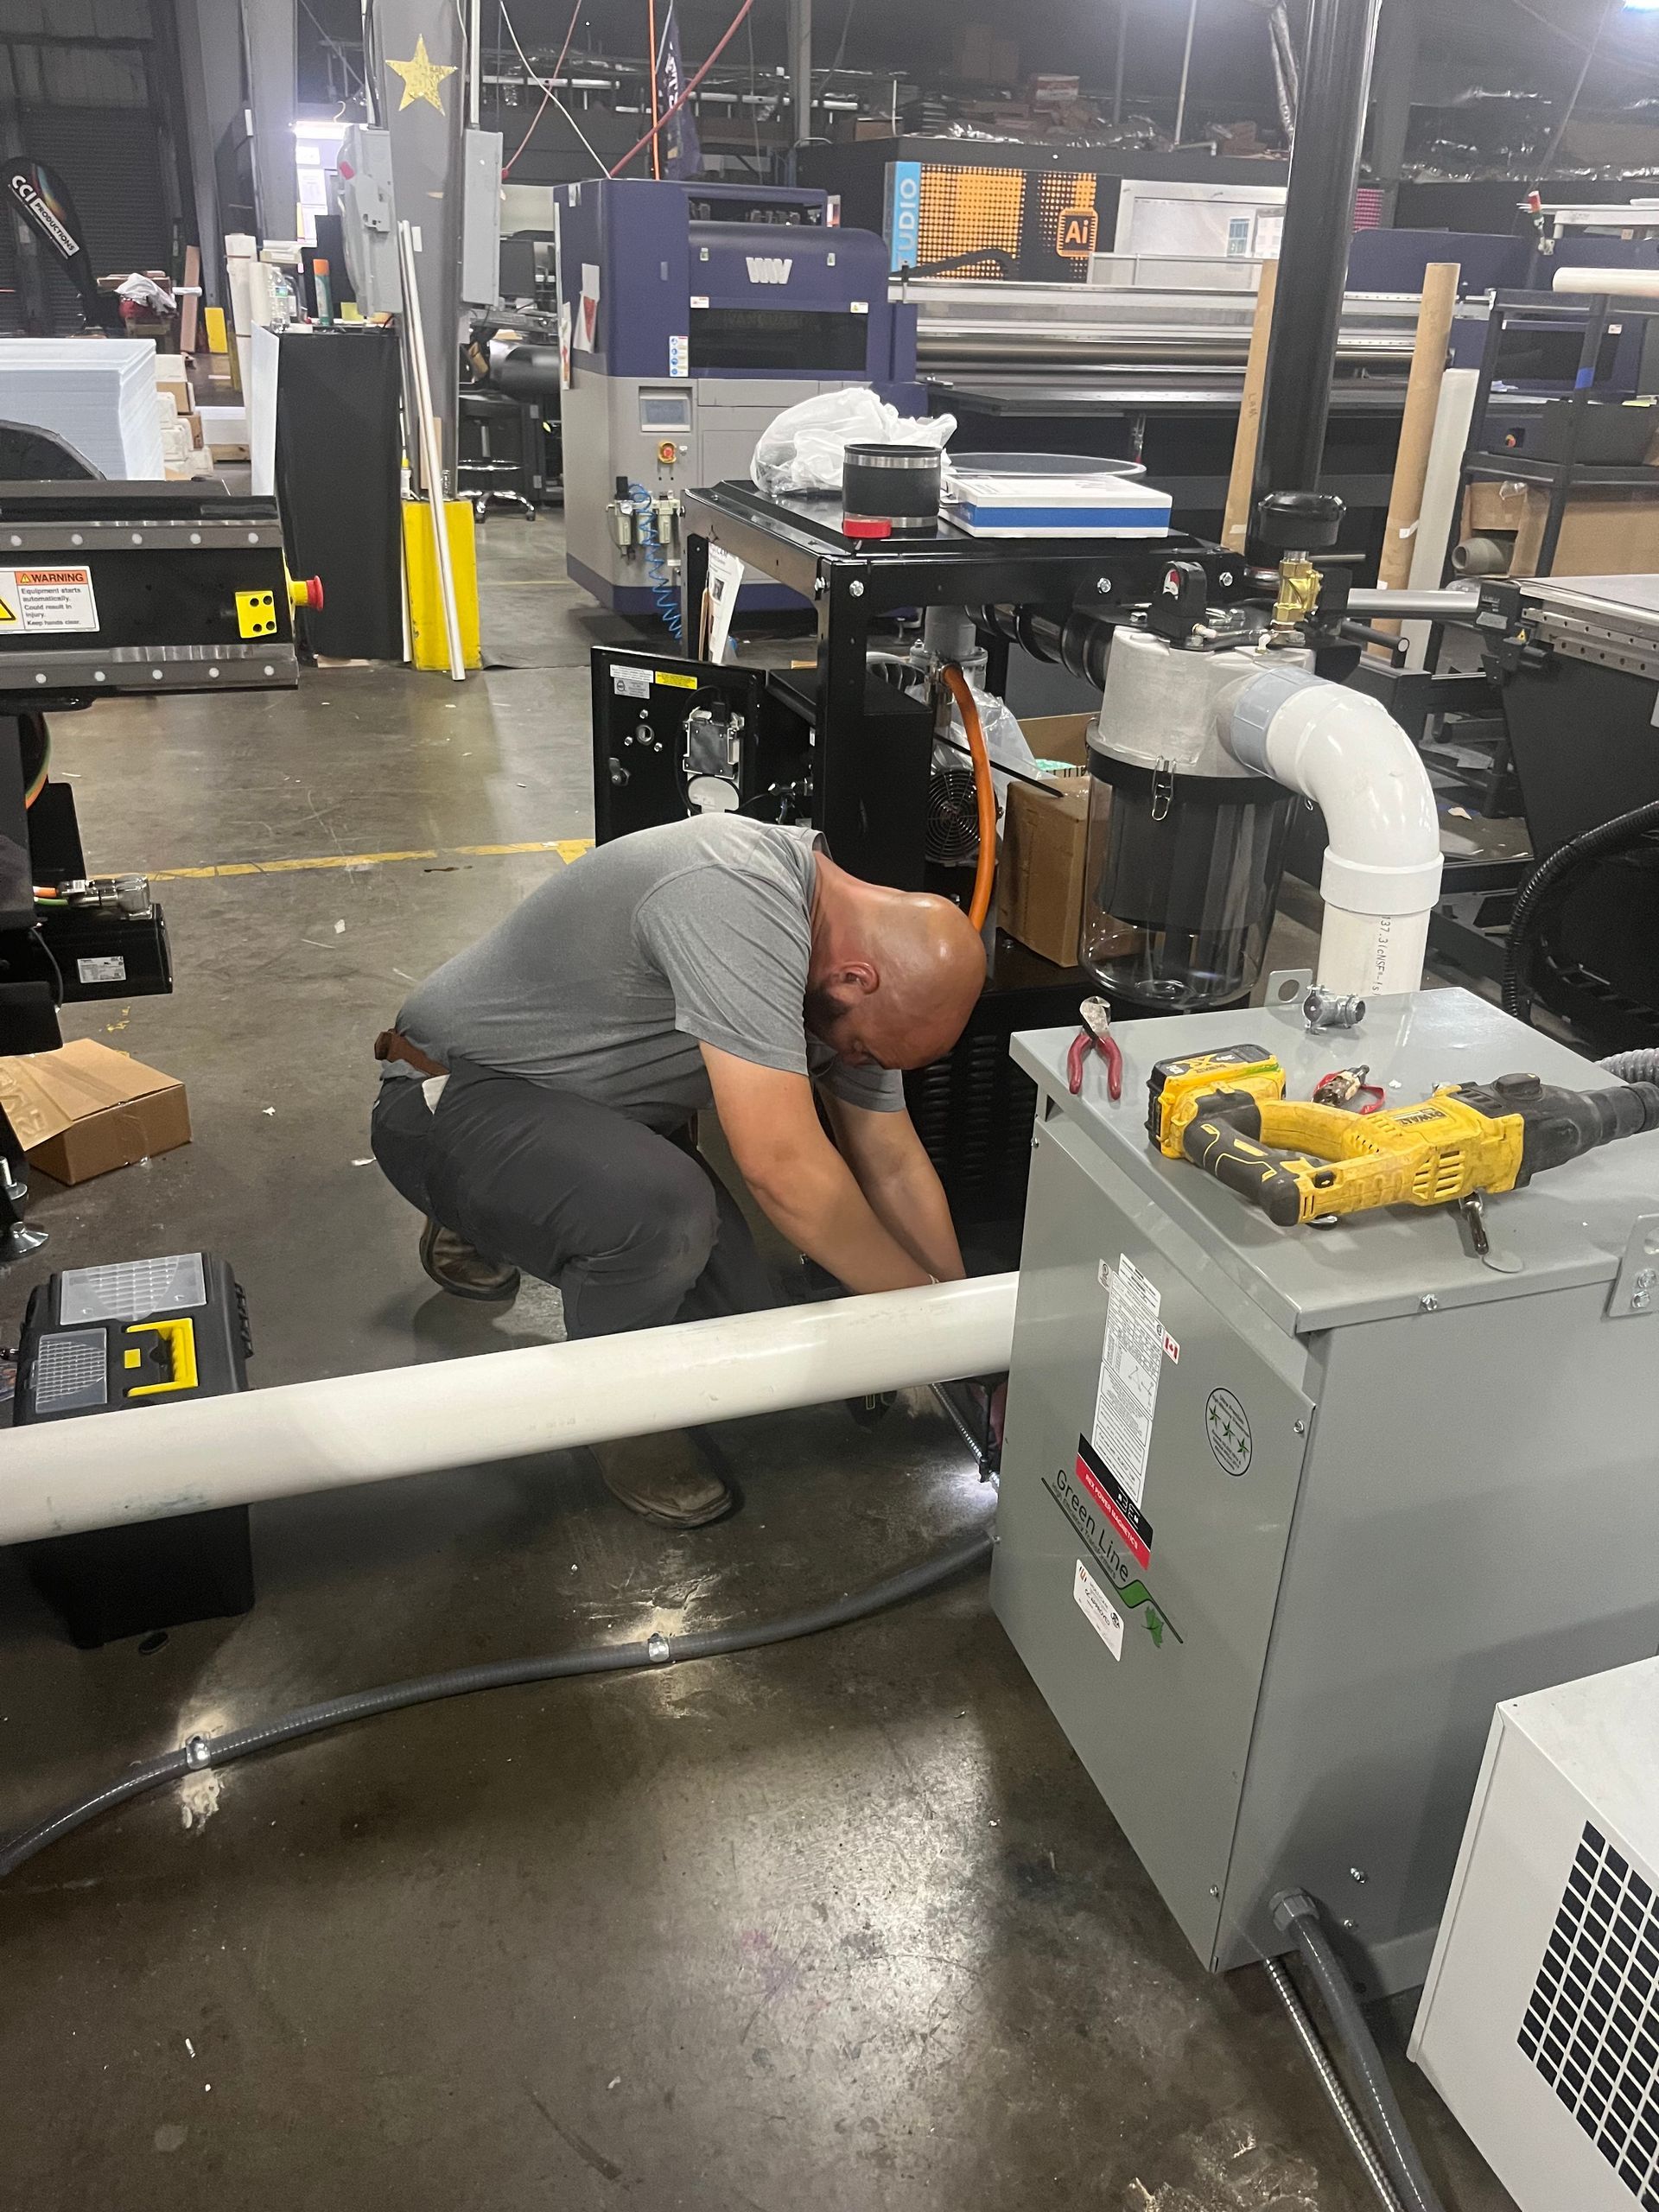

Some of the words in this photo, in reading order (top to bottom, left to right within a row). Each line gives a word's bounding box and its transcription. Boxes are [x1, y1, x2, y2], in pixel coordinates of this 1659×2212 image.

[11, 175, 37, 202] CCI
[35, 202, 75, 251] PRODUCTIONS
[1065, 219, 1089, 244] Ai
[31, 573, 84, 582] WARNING
[1057, 1470, 1096, 1535] Green
[1098, 1529, 1128, 1582] Line
[1085, 1473, 1095, 1491] REX
[1095, 1486, 1112, 1513] POWER
[1111, 1509, 1138, 1549] MAGNETICS
